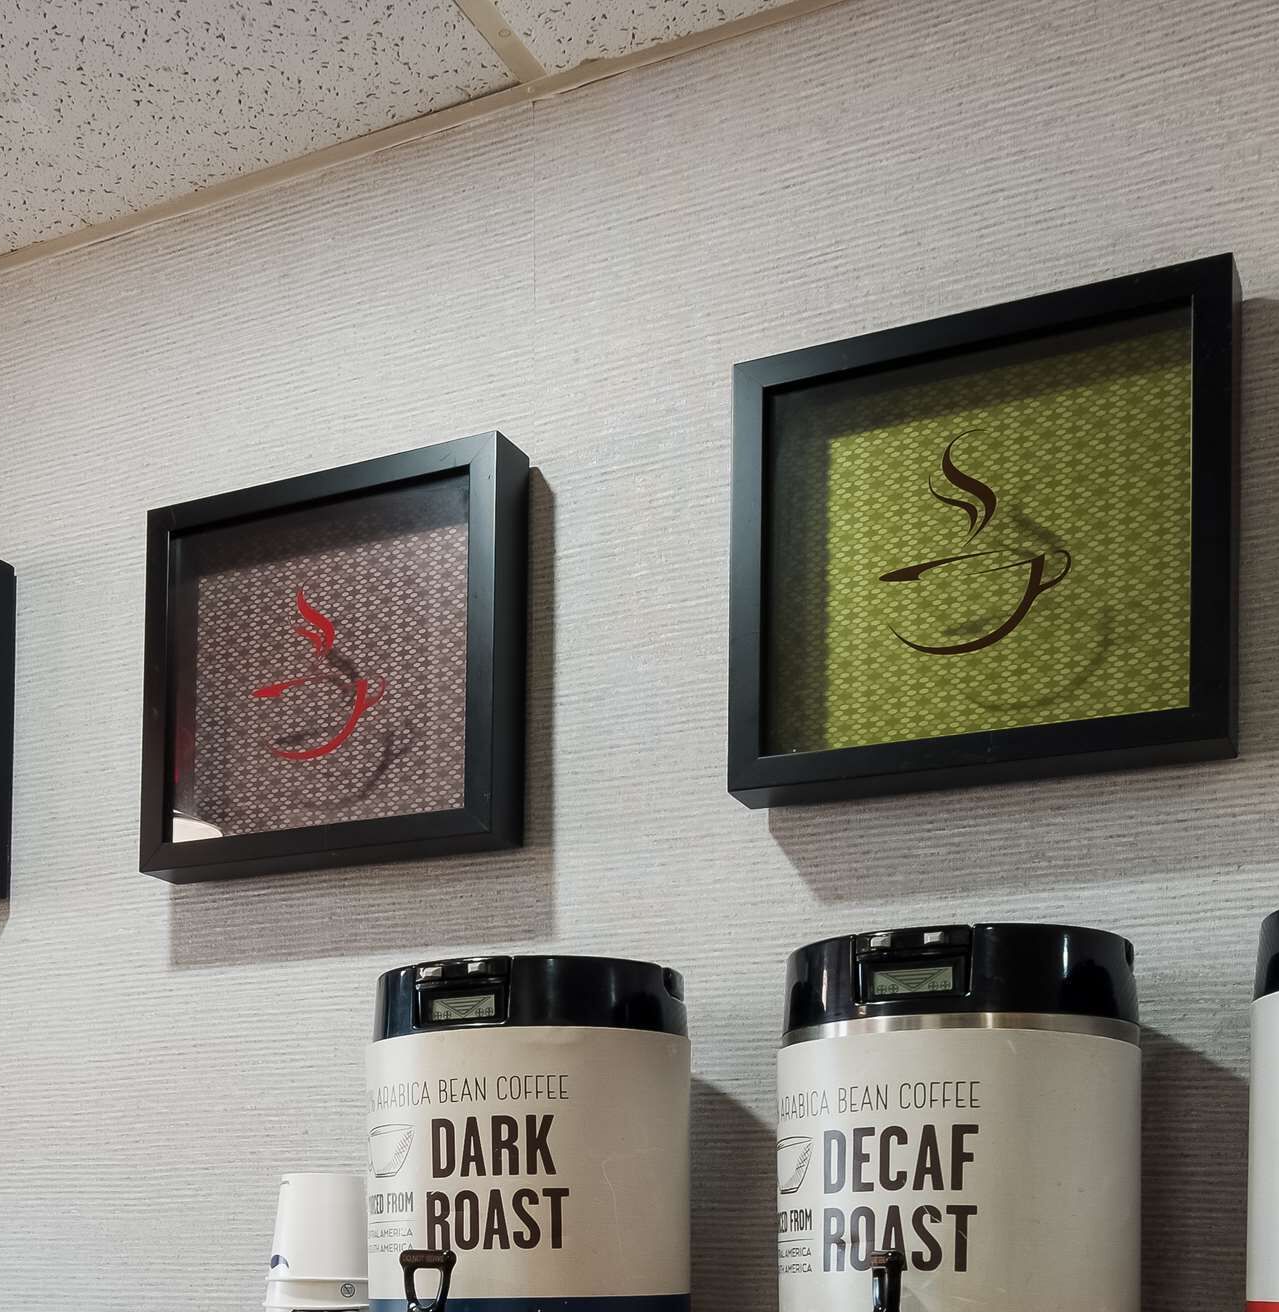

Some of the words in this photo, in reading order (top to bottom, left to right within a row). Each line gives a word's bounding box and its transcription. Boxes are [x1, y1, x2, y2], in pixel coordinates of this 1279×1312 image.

[378, 1080, 431, 1110] ARABICA
[439, 1077, 487, 1104] BEAN
[496, 1074, 569, 1100] COFFEE
[780, 1089, 830, 1120] ARABICA
[838, 1084, 889, 1114] BEAN
[899, 1081, 981, 1109] COFFEE
[431, 1114, 557, 1179] DARK
[823, 1123, 979, 1195] DECAF
[387, 1192, 414, 1214] FROM
[426, 1187, 570, 1251] ROAST
[790, 1209, 812, 1232] FROM
[823, 1204, 978, 1273] ROAST
